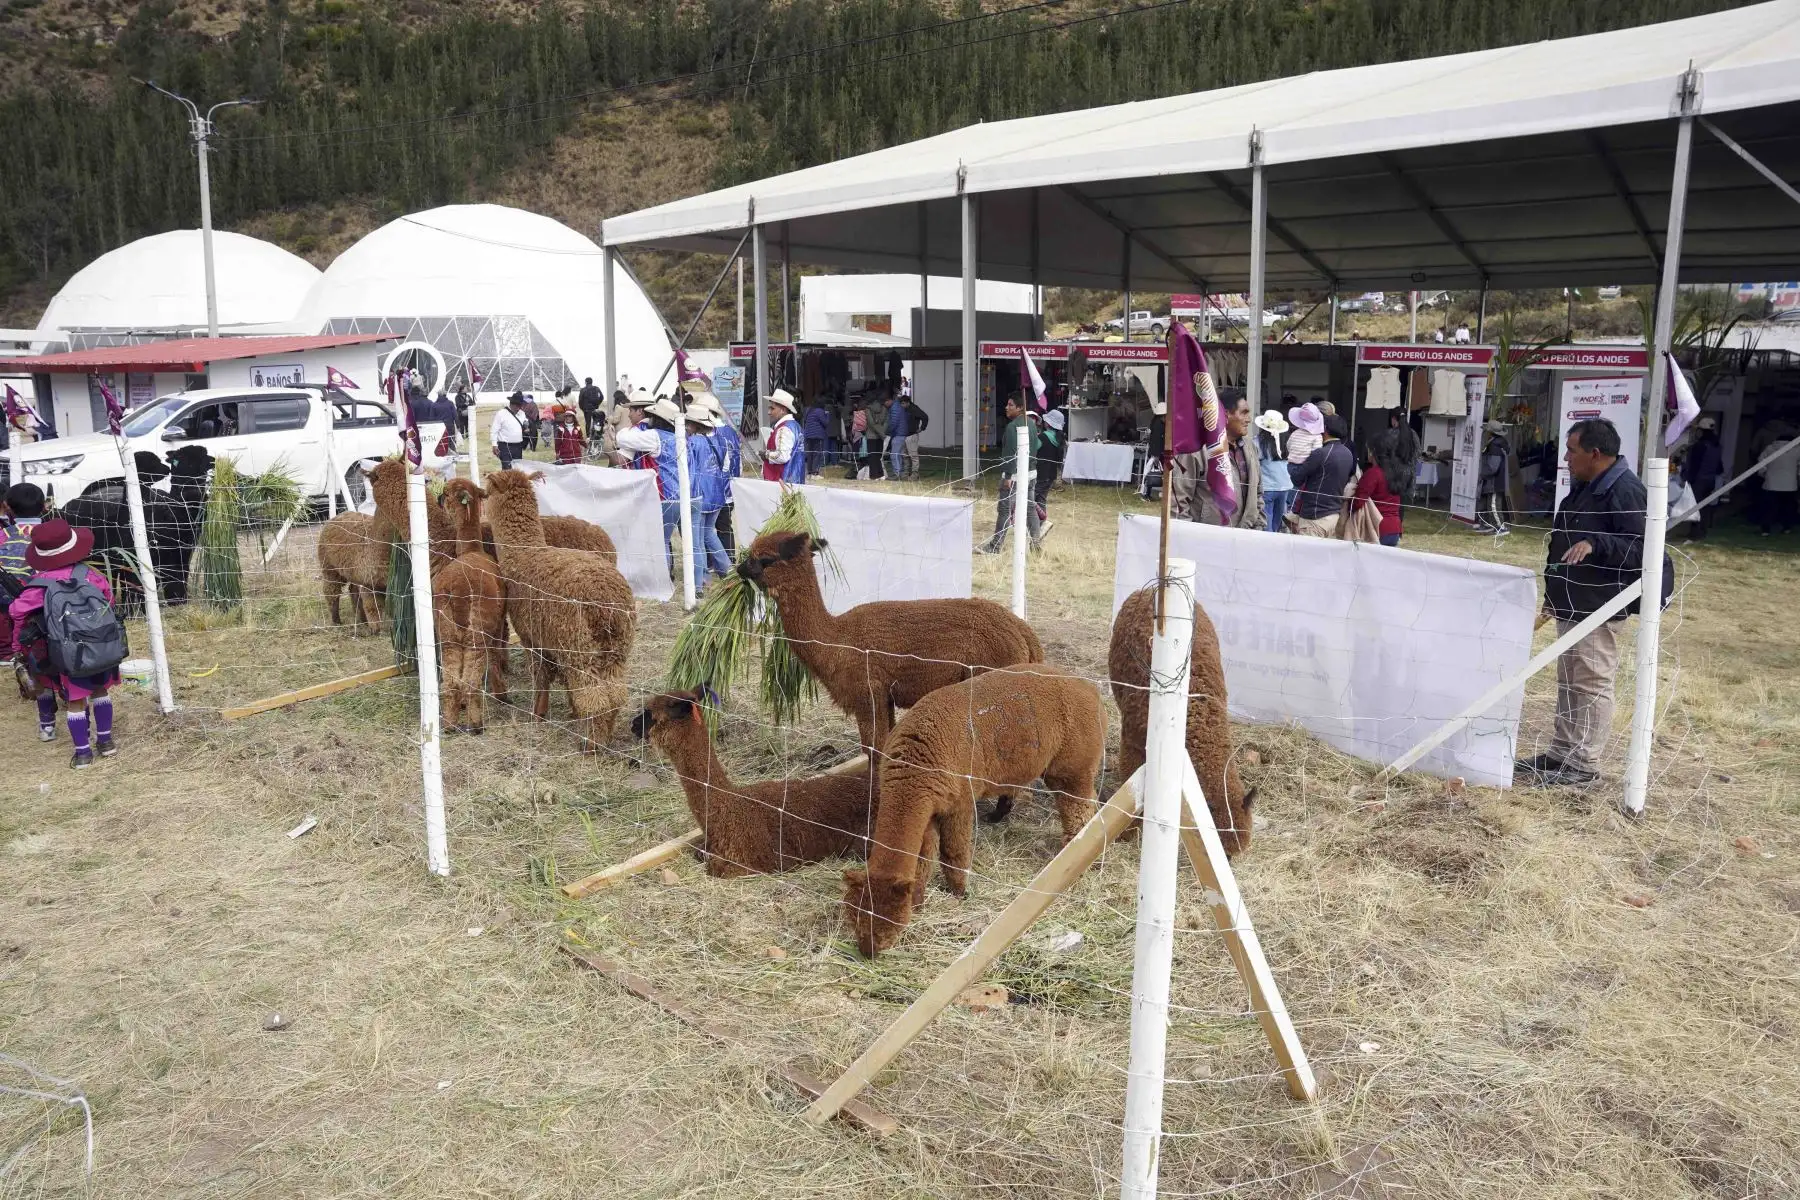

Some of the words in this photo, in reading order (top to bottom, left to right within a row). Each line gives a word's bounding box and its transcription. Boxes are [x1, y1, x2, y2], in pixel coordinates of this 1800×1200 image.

[1036, 347, 1056, 355] ANDES
[1106, 348, 1122, 356] PERÚ
[1136, 350, 1159, 358] ANDES
[1381, 350, 1402, 358] EXPO
[1404, 350, 1426, 359] PERÚ
[1427, 351, 1443, 360] LOS
[1444, 352, 1474, 361] ANDES
[1550, 353, 1576, 362] PERÚ
[1576, 355, 1595, 363] LOS
[1596, 355, 1631, 364] ANDES
[266, 373, 292, 388] BAÑOS
